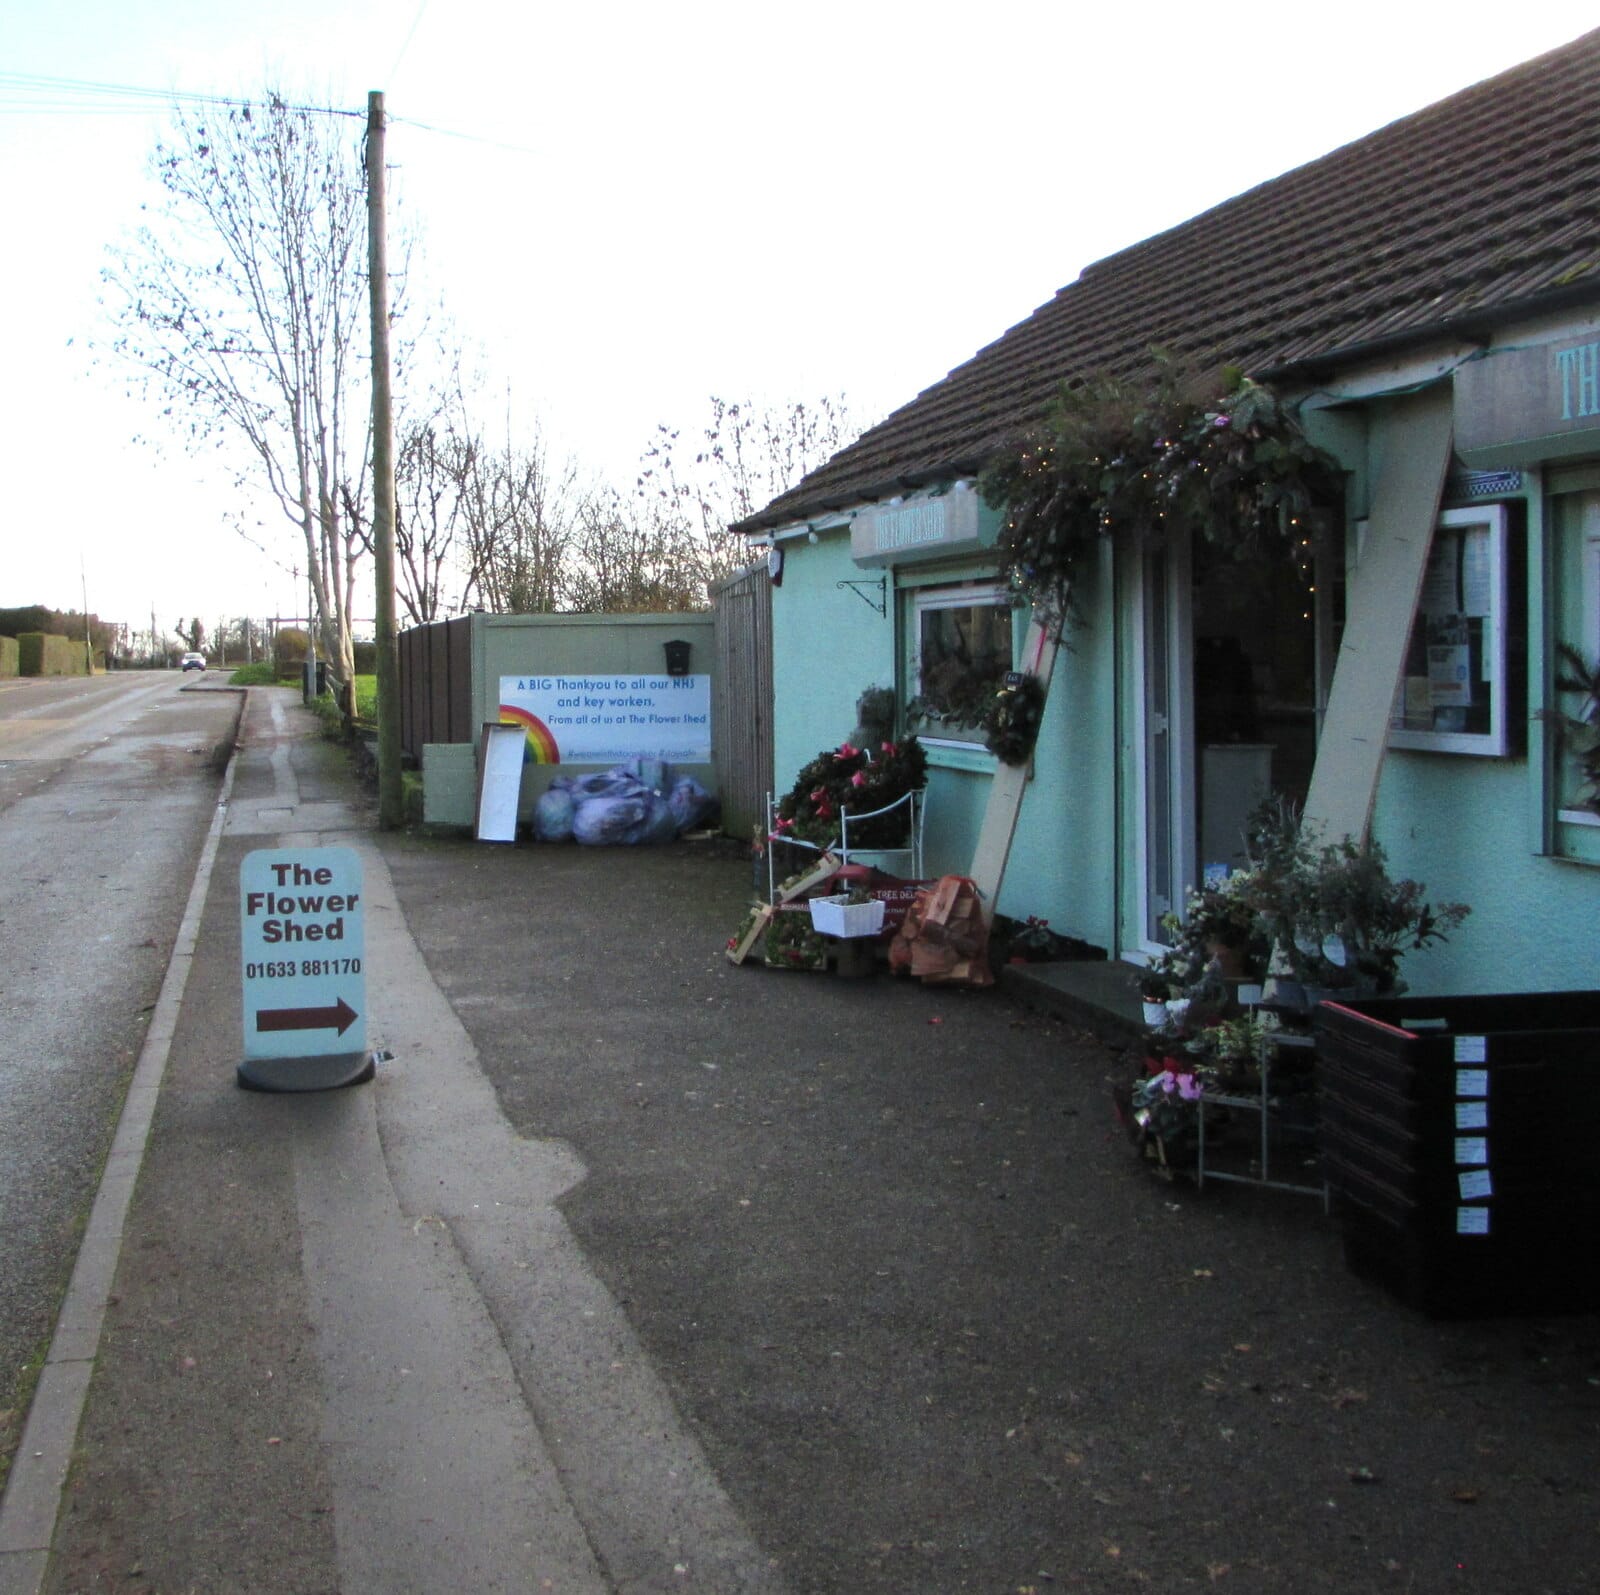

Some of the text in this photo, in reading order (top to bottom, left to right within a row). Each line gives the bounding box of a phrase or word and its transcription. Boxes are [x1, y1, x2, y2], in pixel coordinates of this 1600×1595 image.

[518, 678, 695, 691] A BIG Thankyou to all our NHS
[557, 696, 580, 707] and
[584, 696, 604, 709] key
[549, 715, 572, 724] From
[576, 715, 588, 724] all
[591, 715, 601, 724] of
[616, 715, 625, 724] at
[629, 714, 646, 723] The
[649, 714, 680, 723] Flower
[683, 713, 706, 723] Shed
[271, 863, 333, 886] The
[876, 890, 898, 899] TREE
[247, 892, 359, 916] Flower
[262, 918, 344, 943] Shed
[246, 957, 361, 979] 01633 881170
